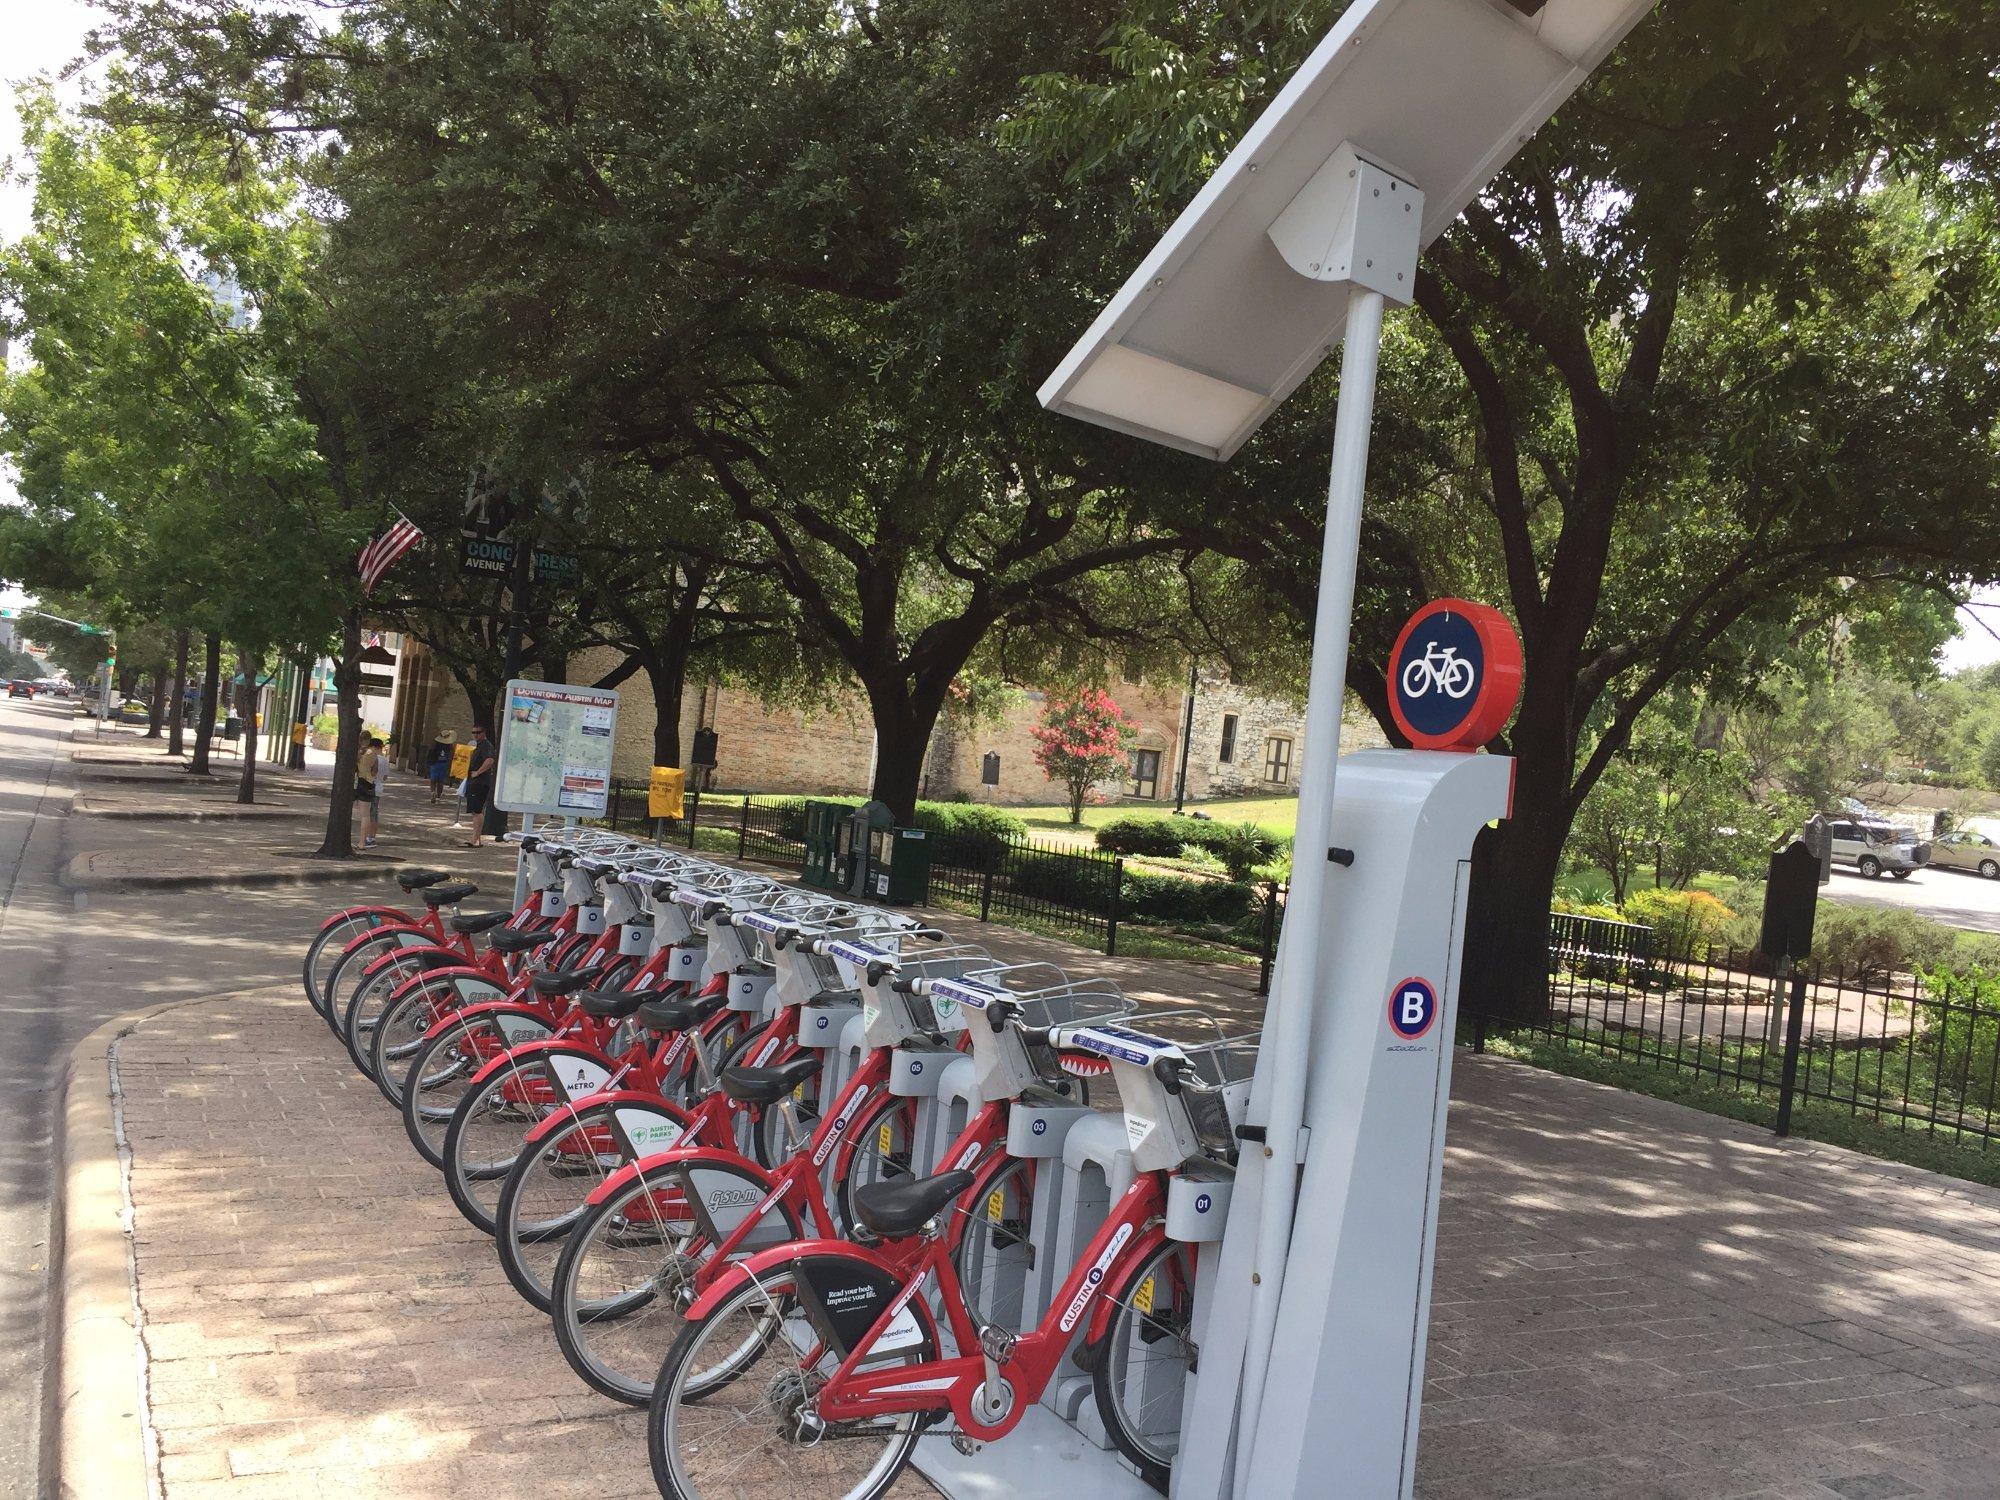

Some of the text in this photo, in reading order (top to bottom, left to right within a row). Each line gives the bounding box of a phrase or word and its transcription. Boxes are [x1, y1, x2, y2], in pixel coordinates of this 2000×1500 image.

[465, 557, 505, 571] AVENUE
[564, 694, 593, 703] AUSTIN
[594, 697, 613, 705] MAP
[1401, 991, 1424, 1024] B
[665, 1037, 683, 1062] AUSTIN
[567, 1082, 594, 1090] METRO
[1033, 1122, 1044, 1131] 03
[816, 1131, 838, 1162] AUSTIN
[1197, 1199, 1208, 1209] 01
[828, 1289, 844, 1298] Read
[844, 1288, 858, 1297] your
[827, 1297, 852, 1306] Improve
[852, 1294, 866, 1302] your
[1063, 1284, 1093, 1328] AUSTIN
[1091, 1271, 1101, 1281] B
